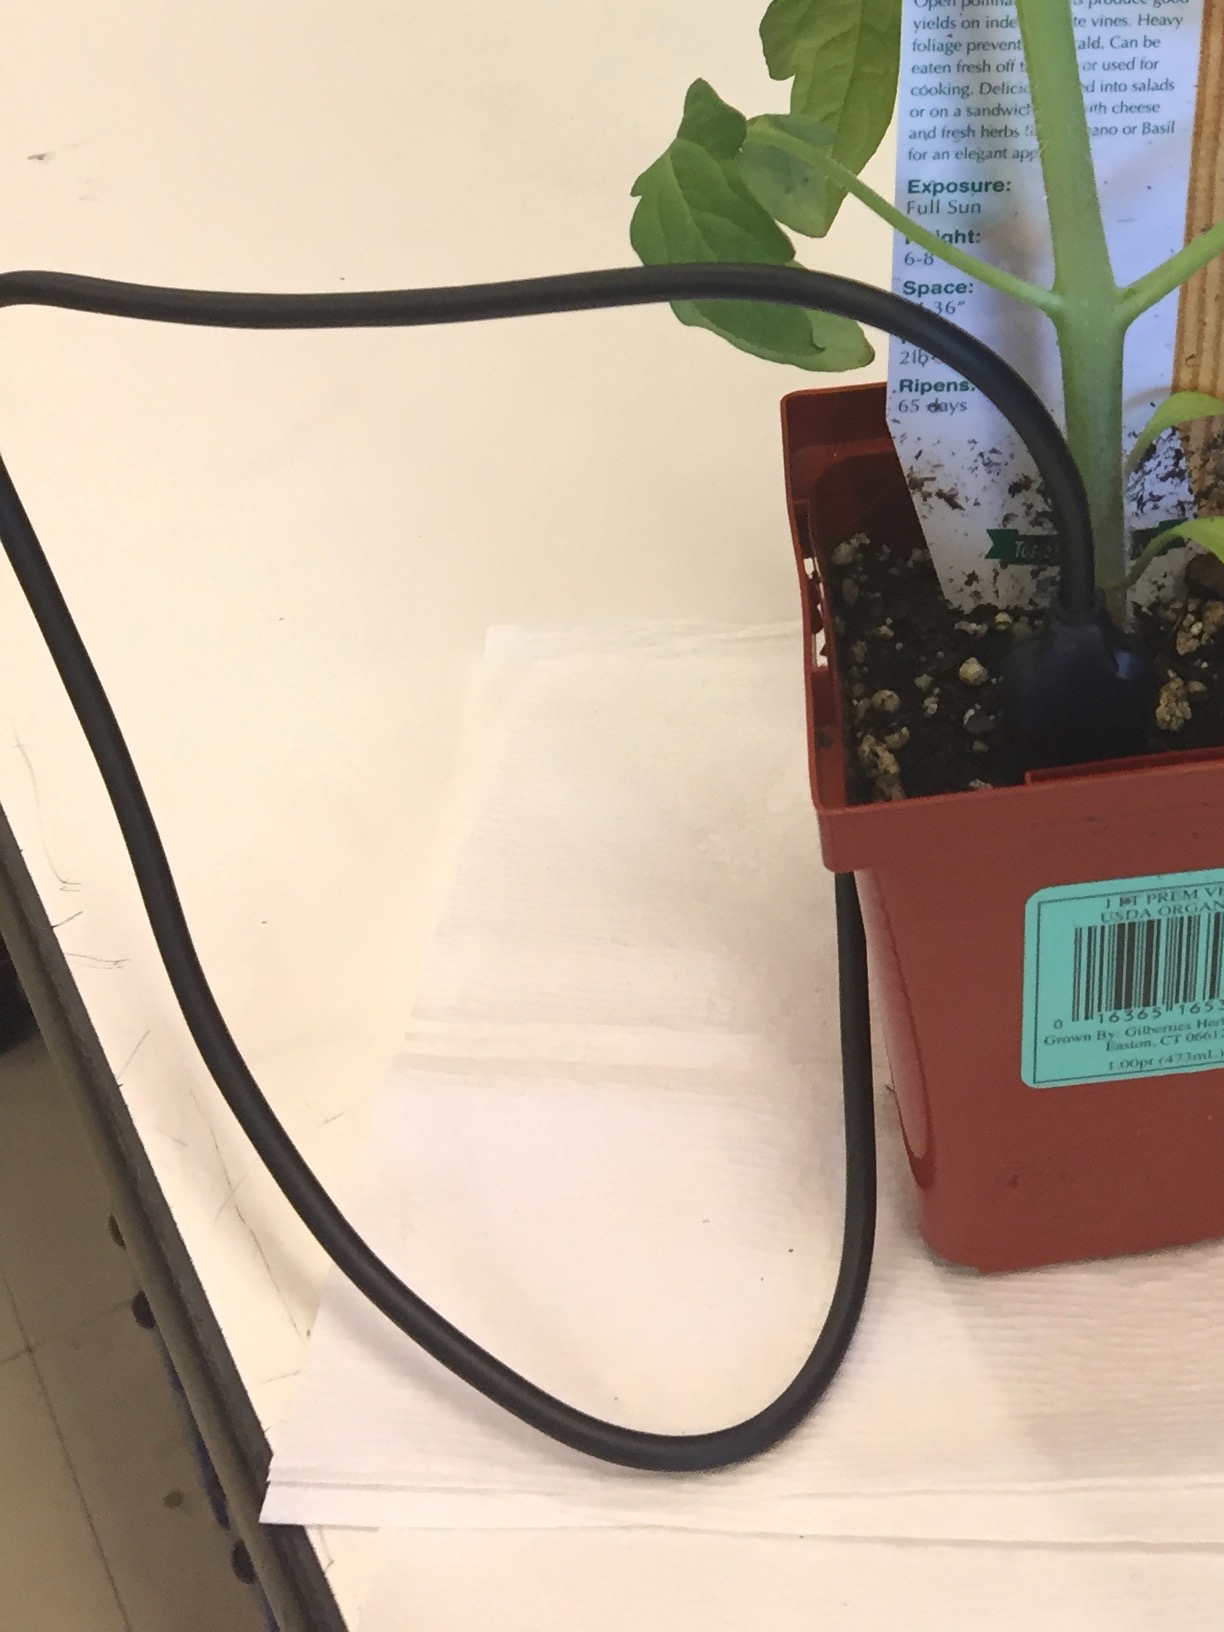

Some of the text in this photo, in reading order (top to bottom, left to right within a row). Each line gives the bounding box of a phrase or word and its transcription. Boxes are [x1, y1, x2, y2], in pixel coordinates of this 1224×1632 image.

[913, 15, 957, 34] yields
[961, 19, 981, 29] on
[1138, 13, 1185, 29] Heavy
[911, 38, 963, 56] foliage
[966, 39, 1022, 56] prevent
[1109, 35, 1138, 49] Can
[1143, 34, 1161, 49] be
[911, 63, 952, 74] eaten
[956, 58, 991, 73] fresh
[995, 58, 1018, 73] off
[1082, 61, 1098, 72] or
[1102, 56, 1136, 71] used
[1140, 56, 1160, 70] for
[910, 81, 974, 99] cooking.
[1100, 79, 1128, 93] into
[1131, 78, 1176, 92] salads
[909, 107, 925, 118] or
[929, 107, 949, 118] on
[953, 107, 962, 118] a
[1111, 100, 1161, 115] cheese
[908, 125, 937, 140] and
[941, 124, 976, 139] fresh
[980, 124, 1020, 139] herbs
[1122, 125, 1138, 136] or
[1141, 120, 1176, 136] Basil
[907, 148, 928, 161] for
[932, 150, 950, 161] an
[954, 147, 1007, 163] elegant
[906, 178, 1012, 197] Exposure:
[906, 199, 983, 216] Full Sun
[902, 279, 974, 298] Space:
[898, 397, 968, 416] 65 days
[1147, 888, 1198, 905] PREM
[1100, 908, 1151, 924] USDA
[1043, 1033, 1092, 1046] Grown
[1159, 1034, 1181, 1046] CT
